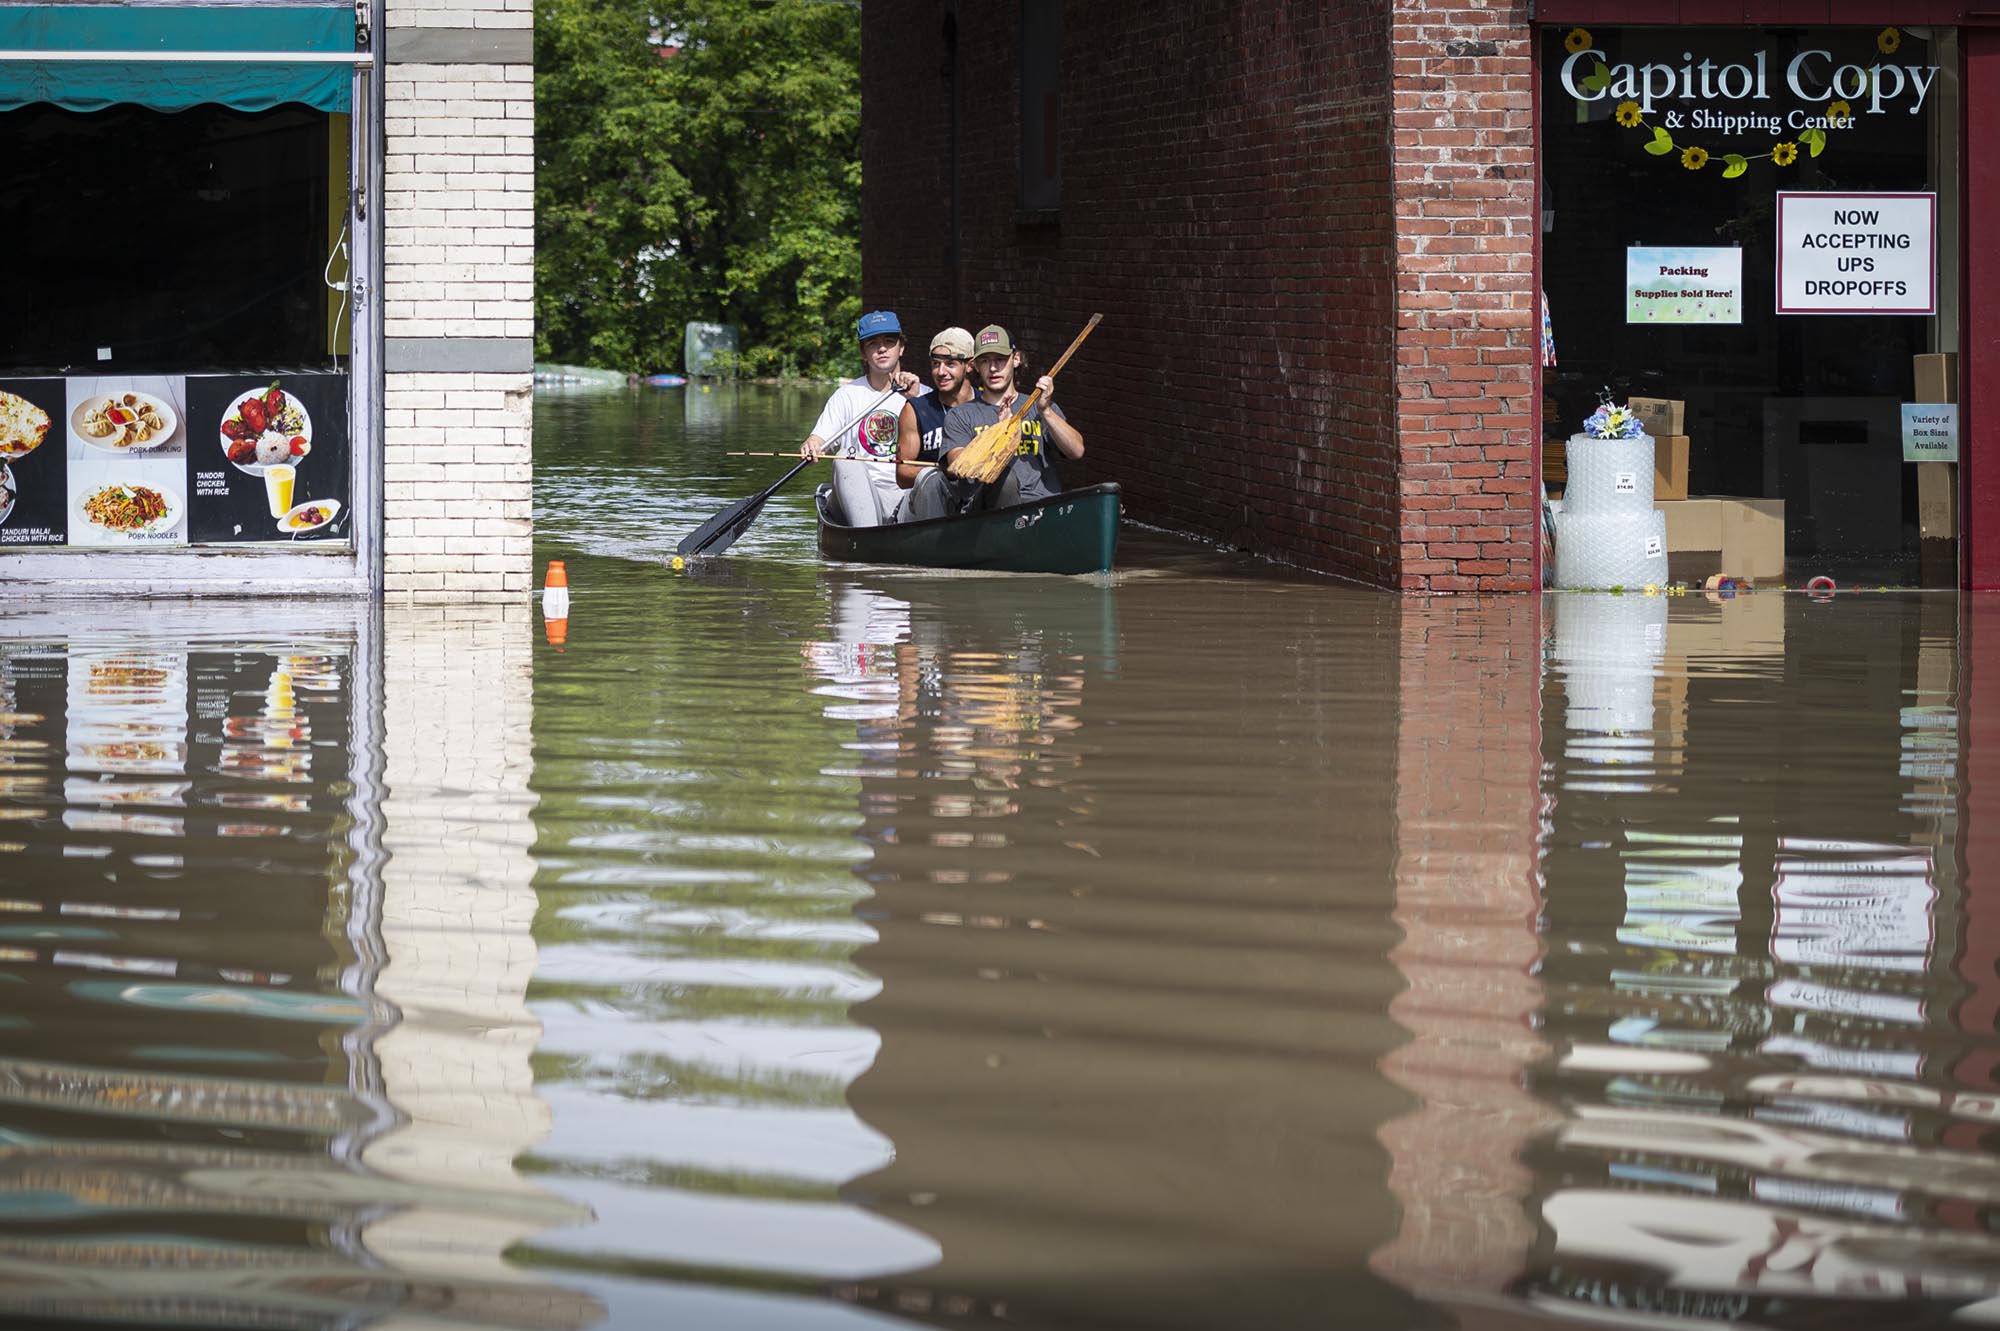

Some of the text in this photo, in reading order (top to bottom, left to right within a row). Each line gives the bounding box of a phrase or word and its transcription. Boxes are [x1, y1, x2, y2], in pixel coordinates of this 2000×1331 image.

[1560, 49, 1940, 115] Capitol Copy
[1665, 109, 1856, 135] & Shipping Center
[1834, 210, 1879, 225] NOW
[1802, 233, 1910, 249] ACCEPTING
[1837, 257, 1875, 272] UPS
[1659, 266, 1708, 277] Packing
[1805, 280, 1907, 295] DROPOFFS
[1635, 290, 1733, 299] Supplies Sold Here!
[1912, 415, 1950, 425] Variety of
[1913, 428, 1949, 437] Box Sizes
[1914, 441, 1949, 450] Available
[196, 472, 225, 480] TANDORI
[196, 480, 226, 488] CHICKEN
[196, 487, 230, 496] WITH RICE
[1, 527, 51, 536] TANDURI MALAI
[147, 532, 178, 540] NOODLES
[1, 535, 30, 543] CHICKEN
[48, 534, 65, 542] RICE
